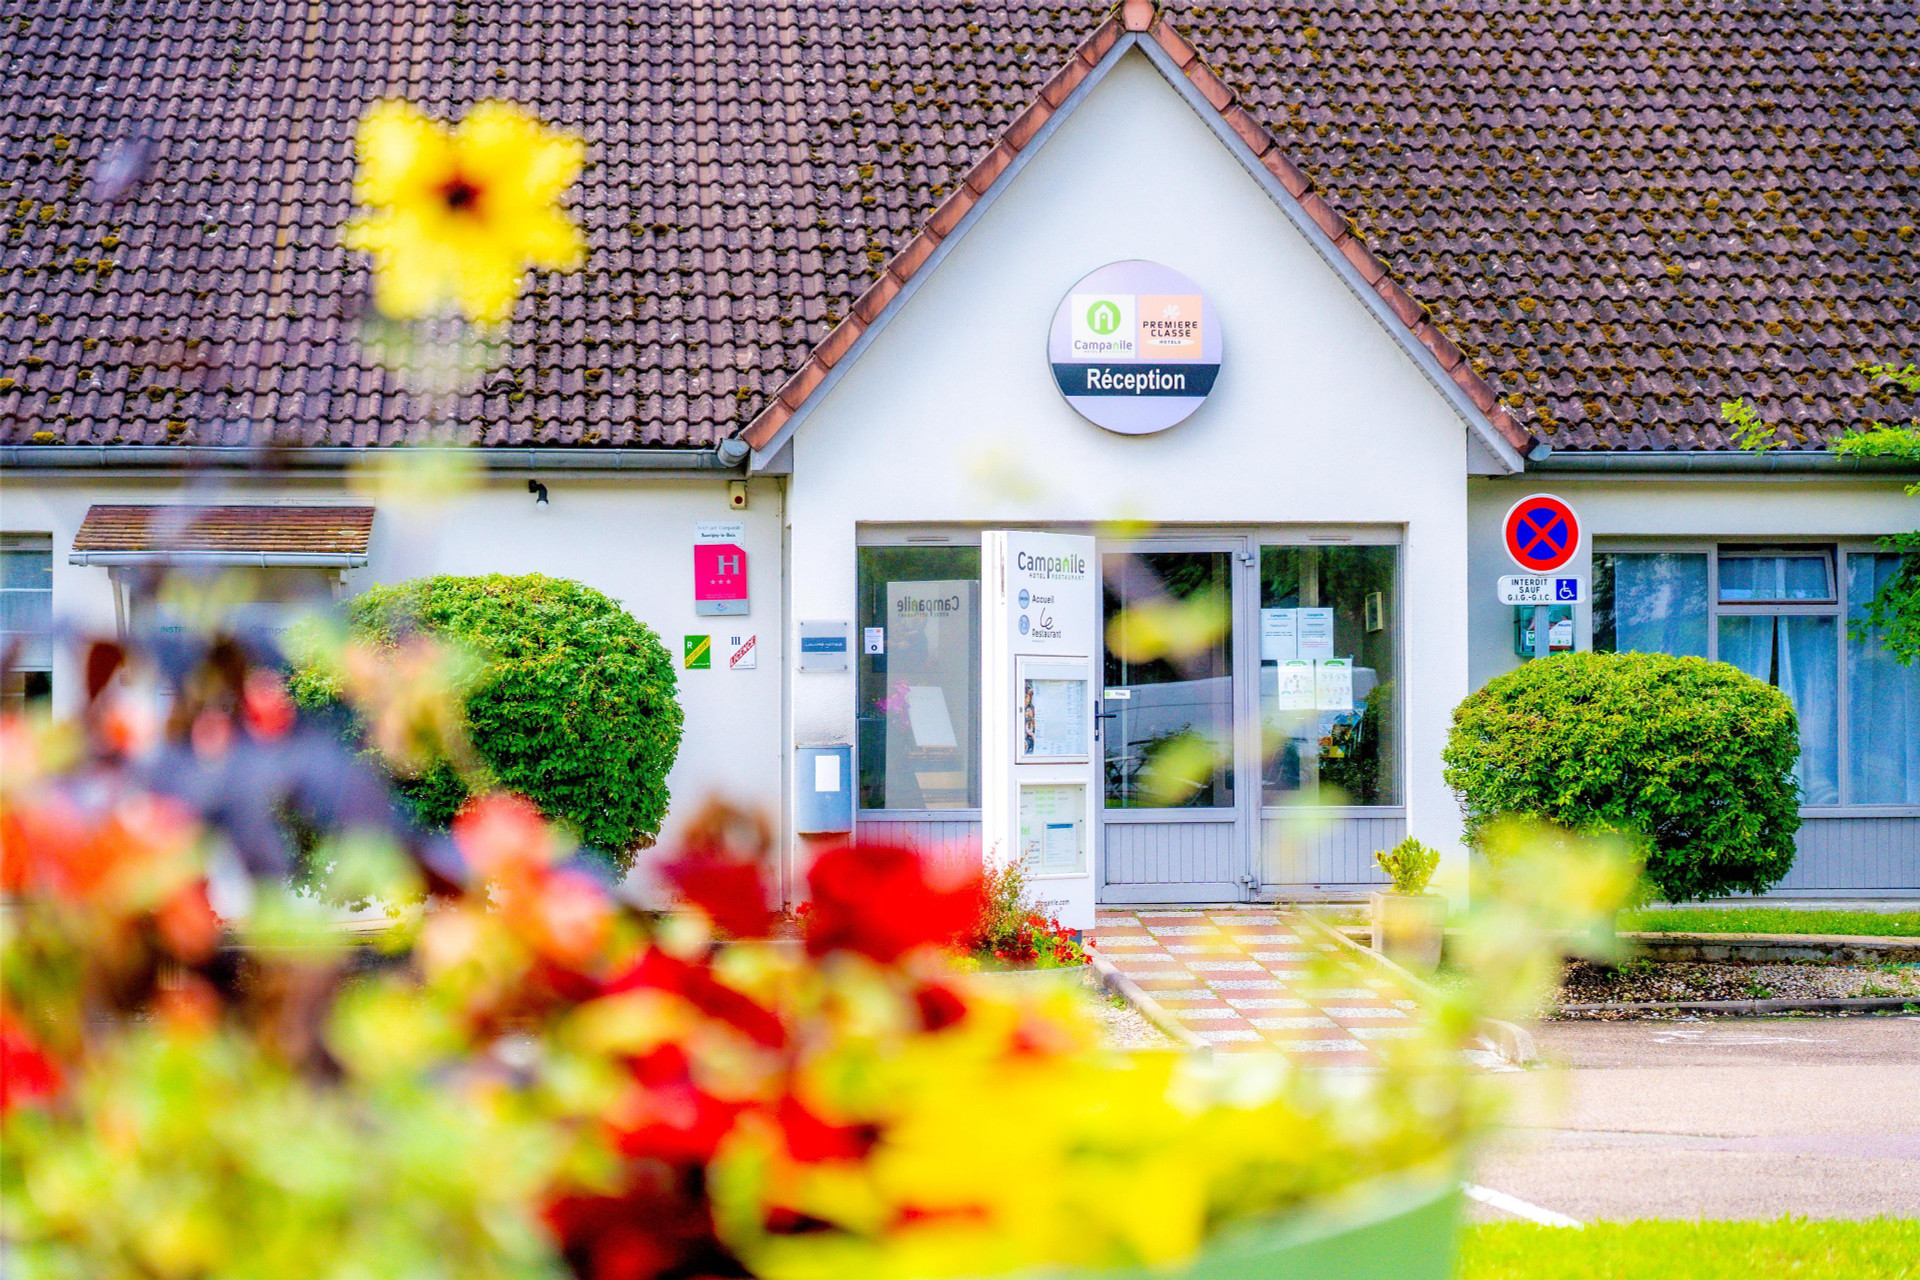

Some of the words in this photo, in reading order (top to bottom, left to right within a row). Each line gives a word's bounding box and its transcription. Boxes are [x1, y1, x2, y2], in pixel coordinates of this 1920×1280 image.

[1143, 321, 1198, 329] PREMIERE
[1151, 329, 1191, 337] CLASSE
[1074, 340, 1133, 353] Campanile
[1087, 369, 1185, 394] Réception
[717, 555, 740, 575] H
[1018, 551, 1085, 579] Campanile
[1032, 595, 1054, 603] Accueil
[1032, 629, 1061, 638] Restaurant
[687, 641, 693, 649] R
[730, 636, 756, 667] LICENCE
